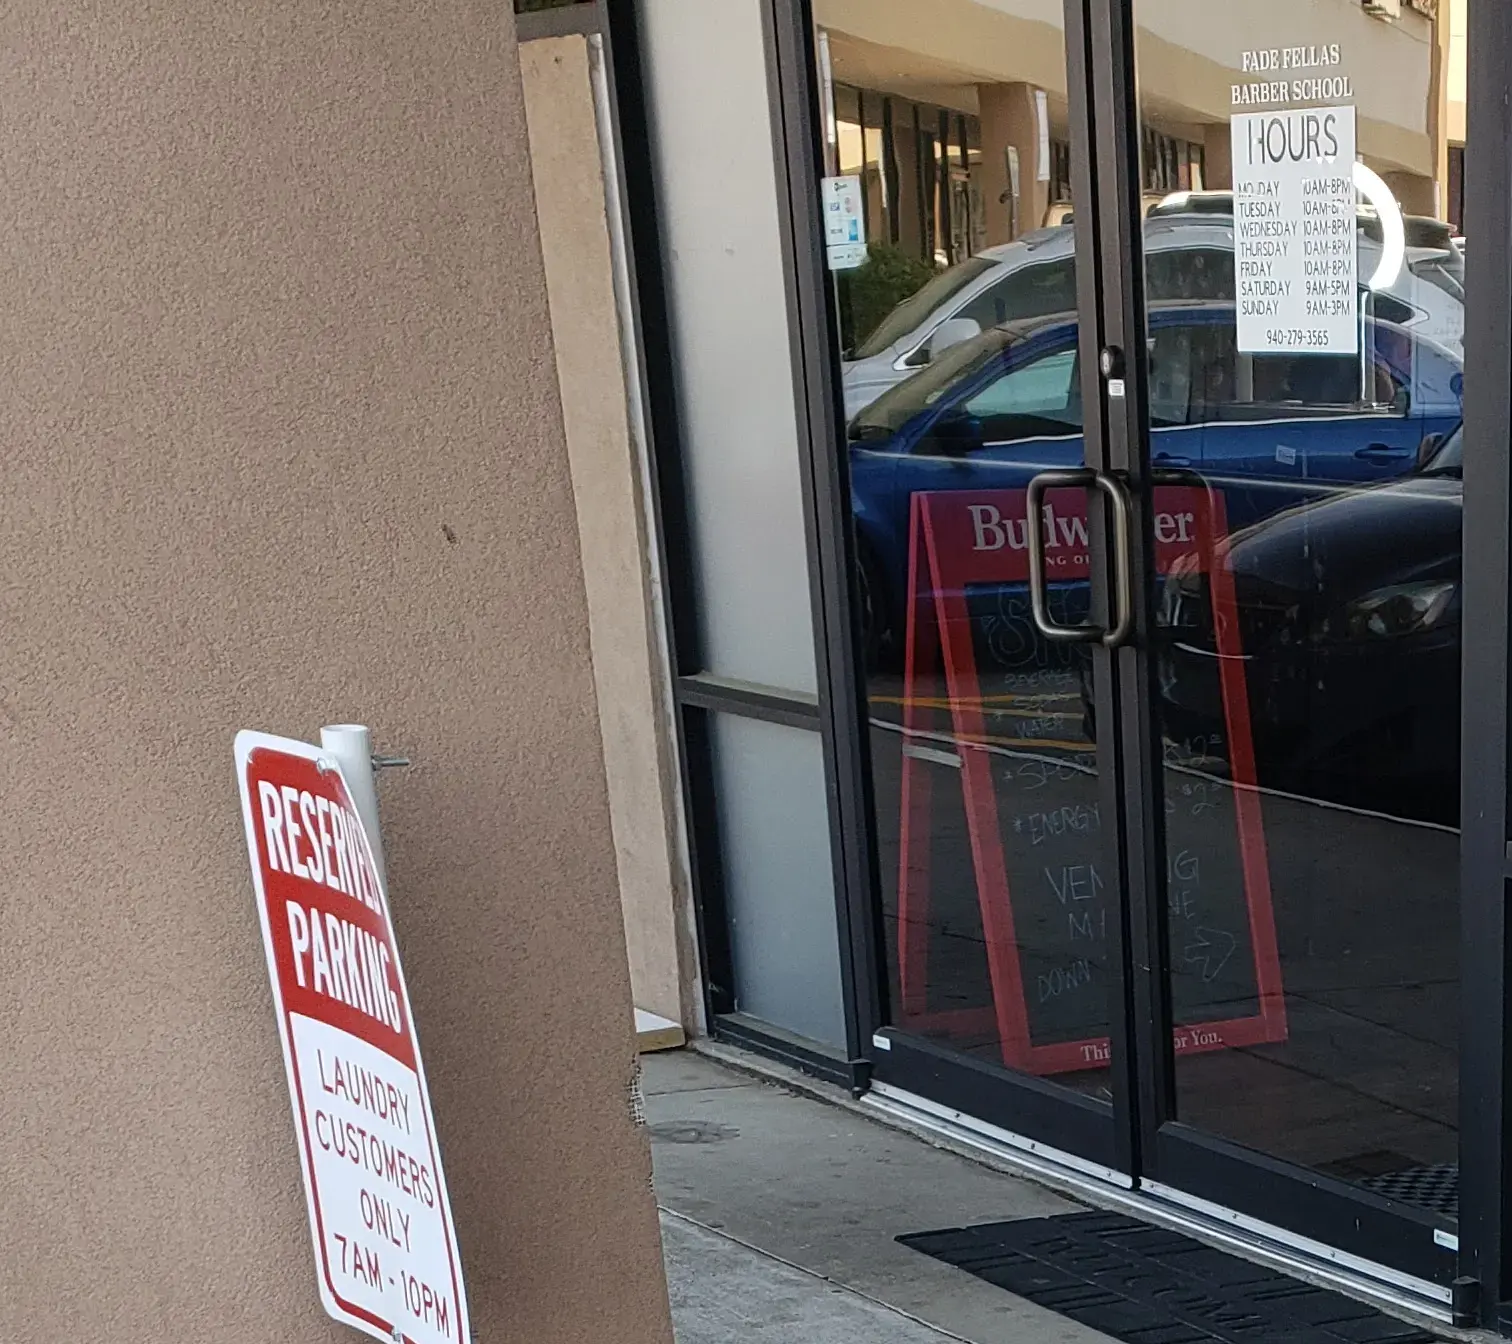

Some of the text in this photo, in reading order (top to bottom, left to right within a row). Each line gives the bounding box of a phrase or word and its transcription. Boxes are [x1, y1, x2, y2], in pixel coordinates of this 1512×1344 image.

[1242, 44, 1340, 72] FADE FELLAS
[1231, 76, 1353, 105] BARBER SCHOOL
[1247, 114, 1338, 165] HOURS
[1239, 201, 1280, 218] TUESDAY
[1240, 219, 1350, 237] WEDNESDAY 10AM-8PM
[1241, 240, 1351, 257] THURSDAY 10AM-8PM
[1241, 260, 1351, 277] FRIDAY 10AM-8PM
[1242, 280, 1350, 296] SATURDAY 9AM-5PM
[1243, 300, 1350, 315] SUNDAY 9AM-3PM
[1267, 329, 1328, 345] 940-279-3565
[286, 900, 401, 1034] PARKING
[1190, 1029, 1223, 1046] You.
[317, 1048, 410, 1135] LAUNDRY
[315, 1110, 434, 1209] CUSTOMERS
[360, 1189, 411, 1253] ONLY
[334, 1233, 383, 1293] 7AM
[402, 1270, 450, 1339] 10PM
